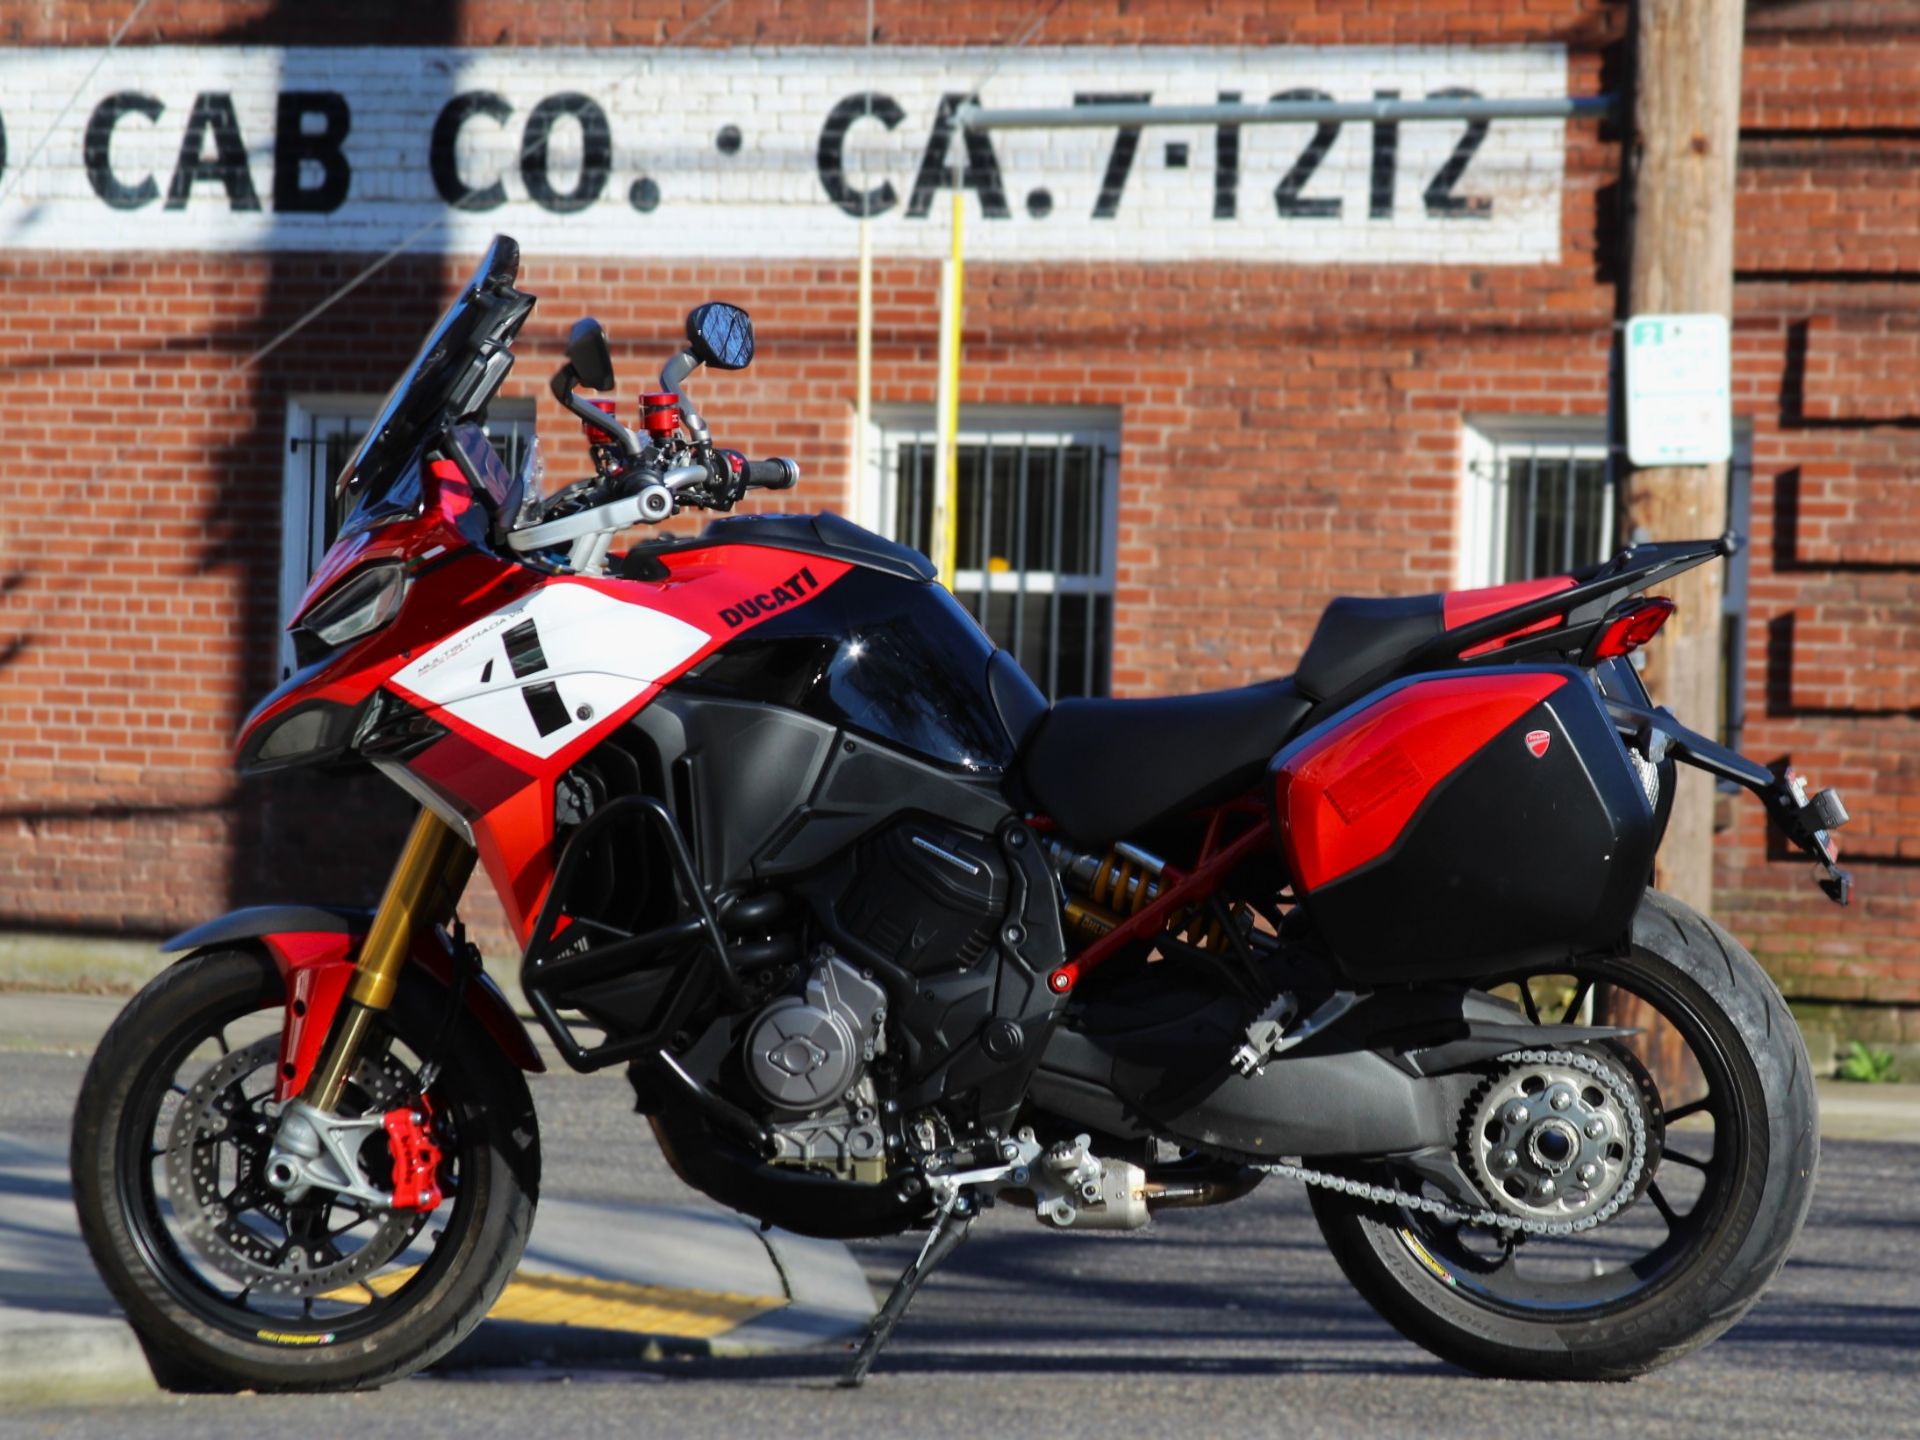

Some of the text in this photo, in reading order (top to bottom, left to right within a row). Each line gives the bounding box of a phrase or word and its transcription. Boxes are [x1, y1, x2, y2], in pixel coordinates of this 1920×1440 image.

[84, 90, 352, 213] CAB
[429, 90, 661, 213] CO.
[717, 566, 818, 628] DUCATI
